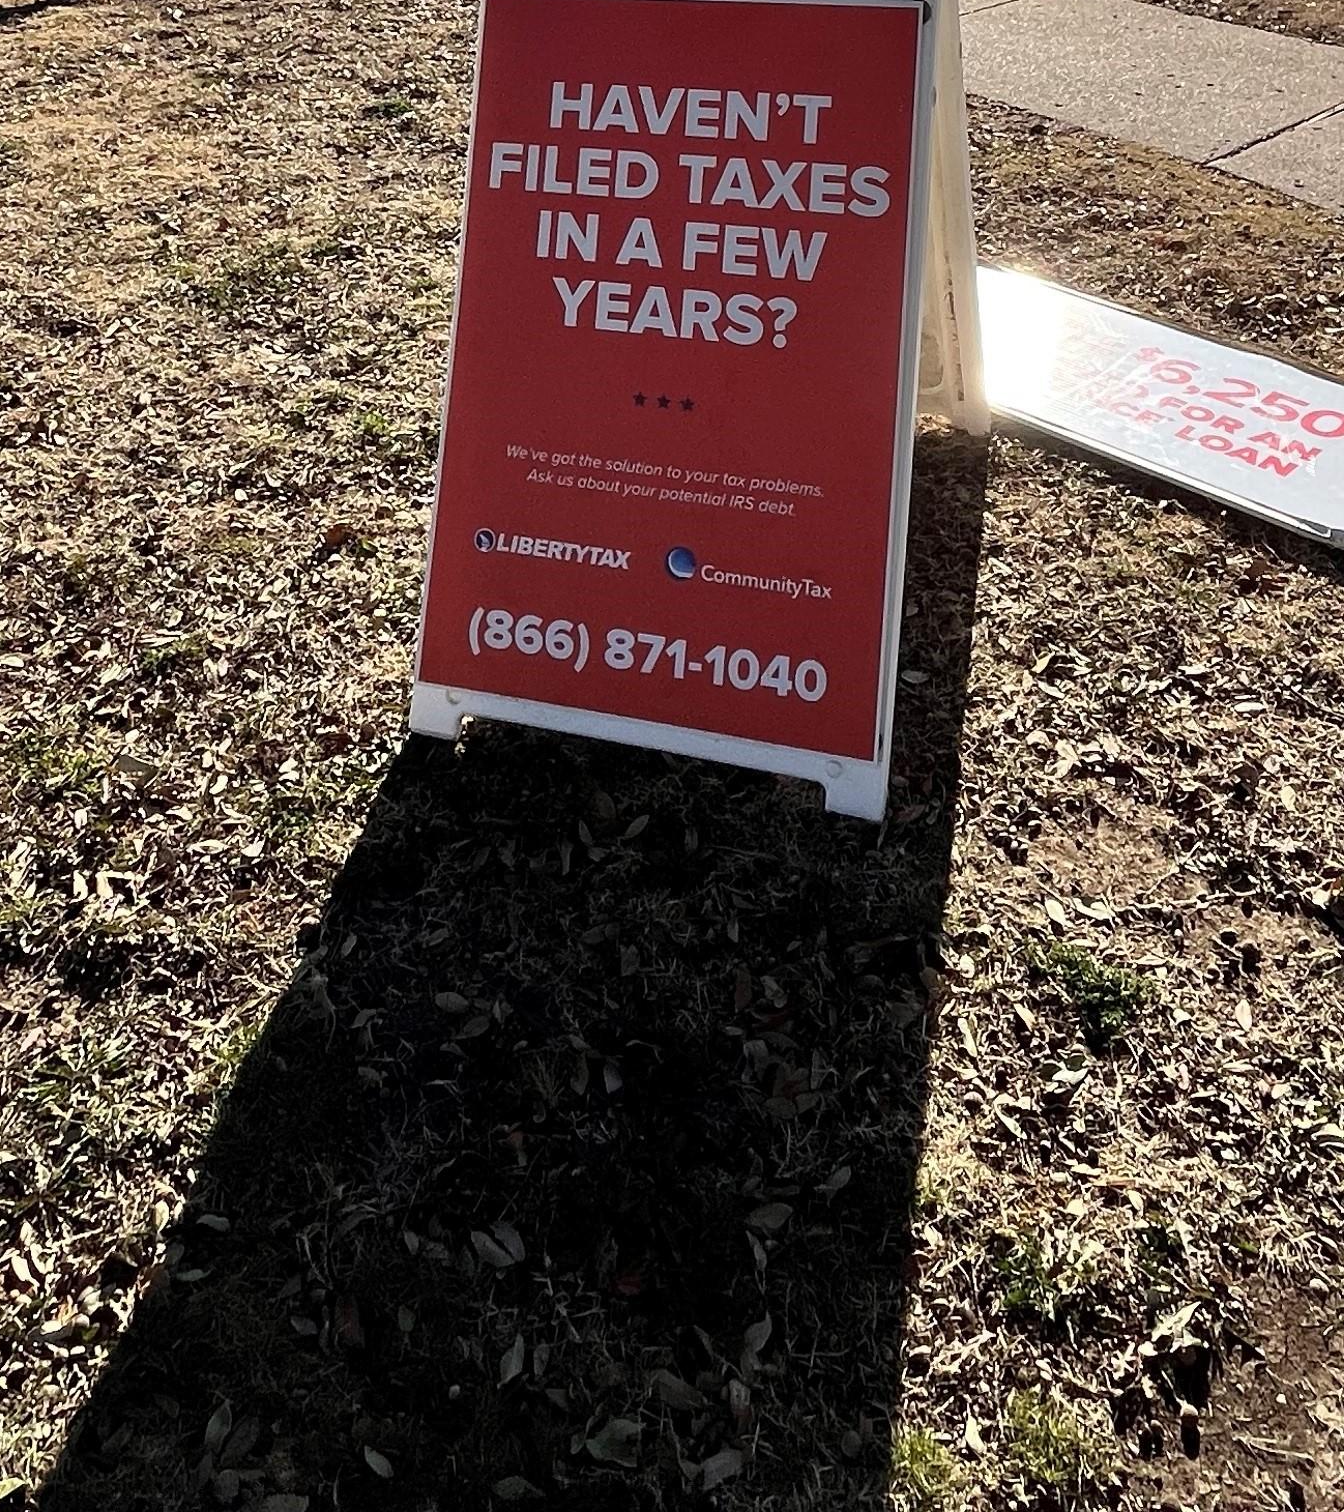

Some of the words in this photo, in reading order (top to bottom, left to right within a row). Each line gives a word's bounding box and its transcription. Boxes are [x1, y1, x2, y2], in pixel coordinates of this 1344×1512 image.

[549, 81, 832, 144] HAVEN'T
[488, 142, 659, 199] FILED
[679, 154, 891, 217] TAXES
[536, 210, 599, 262] IN
[616, 217, 662, 268] A
[682, 221, 827, 281] FEW
[552, 277, 798, 349] YEARS?
[1159, 396, 1245, 435] FOR
[1248, 431, 1323, 462] AN
[1174, 425, 1299, 478] LOAN
[506, 444, 548, 464] We've
[551, 452, 576, 469] got
[578, 454, 602, 469] the
[605, 458, 663, 478] solution
[667, 464, 682, 480] to
[684, 469, 720, 487] your
[723, 473, 746, 489] tax
[748, 476, 825, 499] problems.
[526, 469, 554, 486] Ask
[557, 473, 574, 487] us
[577, 476, 621, 494] about
[622, 482, 657, 499] your
[658, 487, 728, 508] potential
[729, 495, 755, 511] IRS
[701, 565, 833, 600] CommunityTax
[468, 607, 590, 673] (866)
[604, 629, 828, 702] 871-1040
